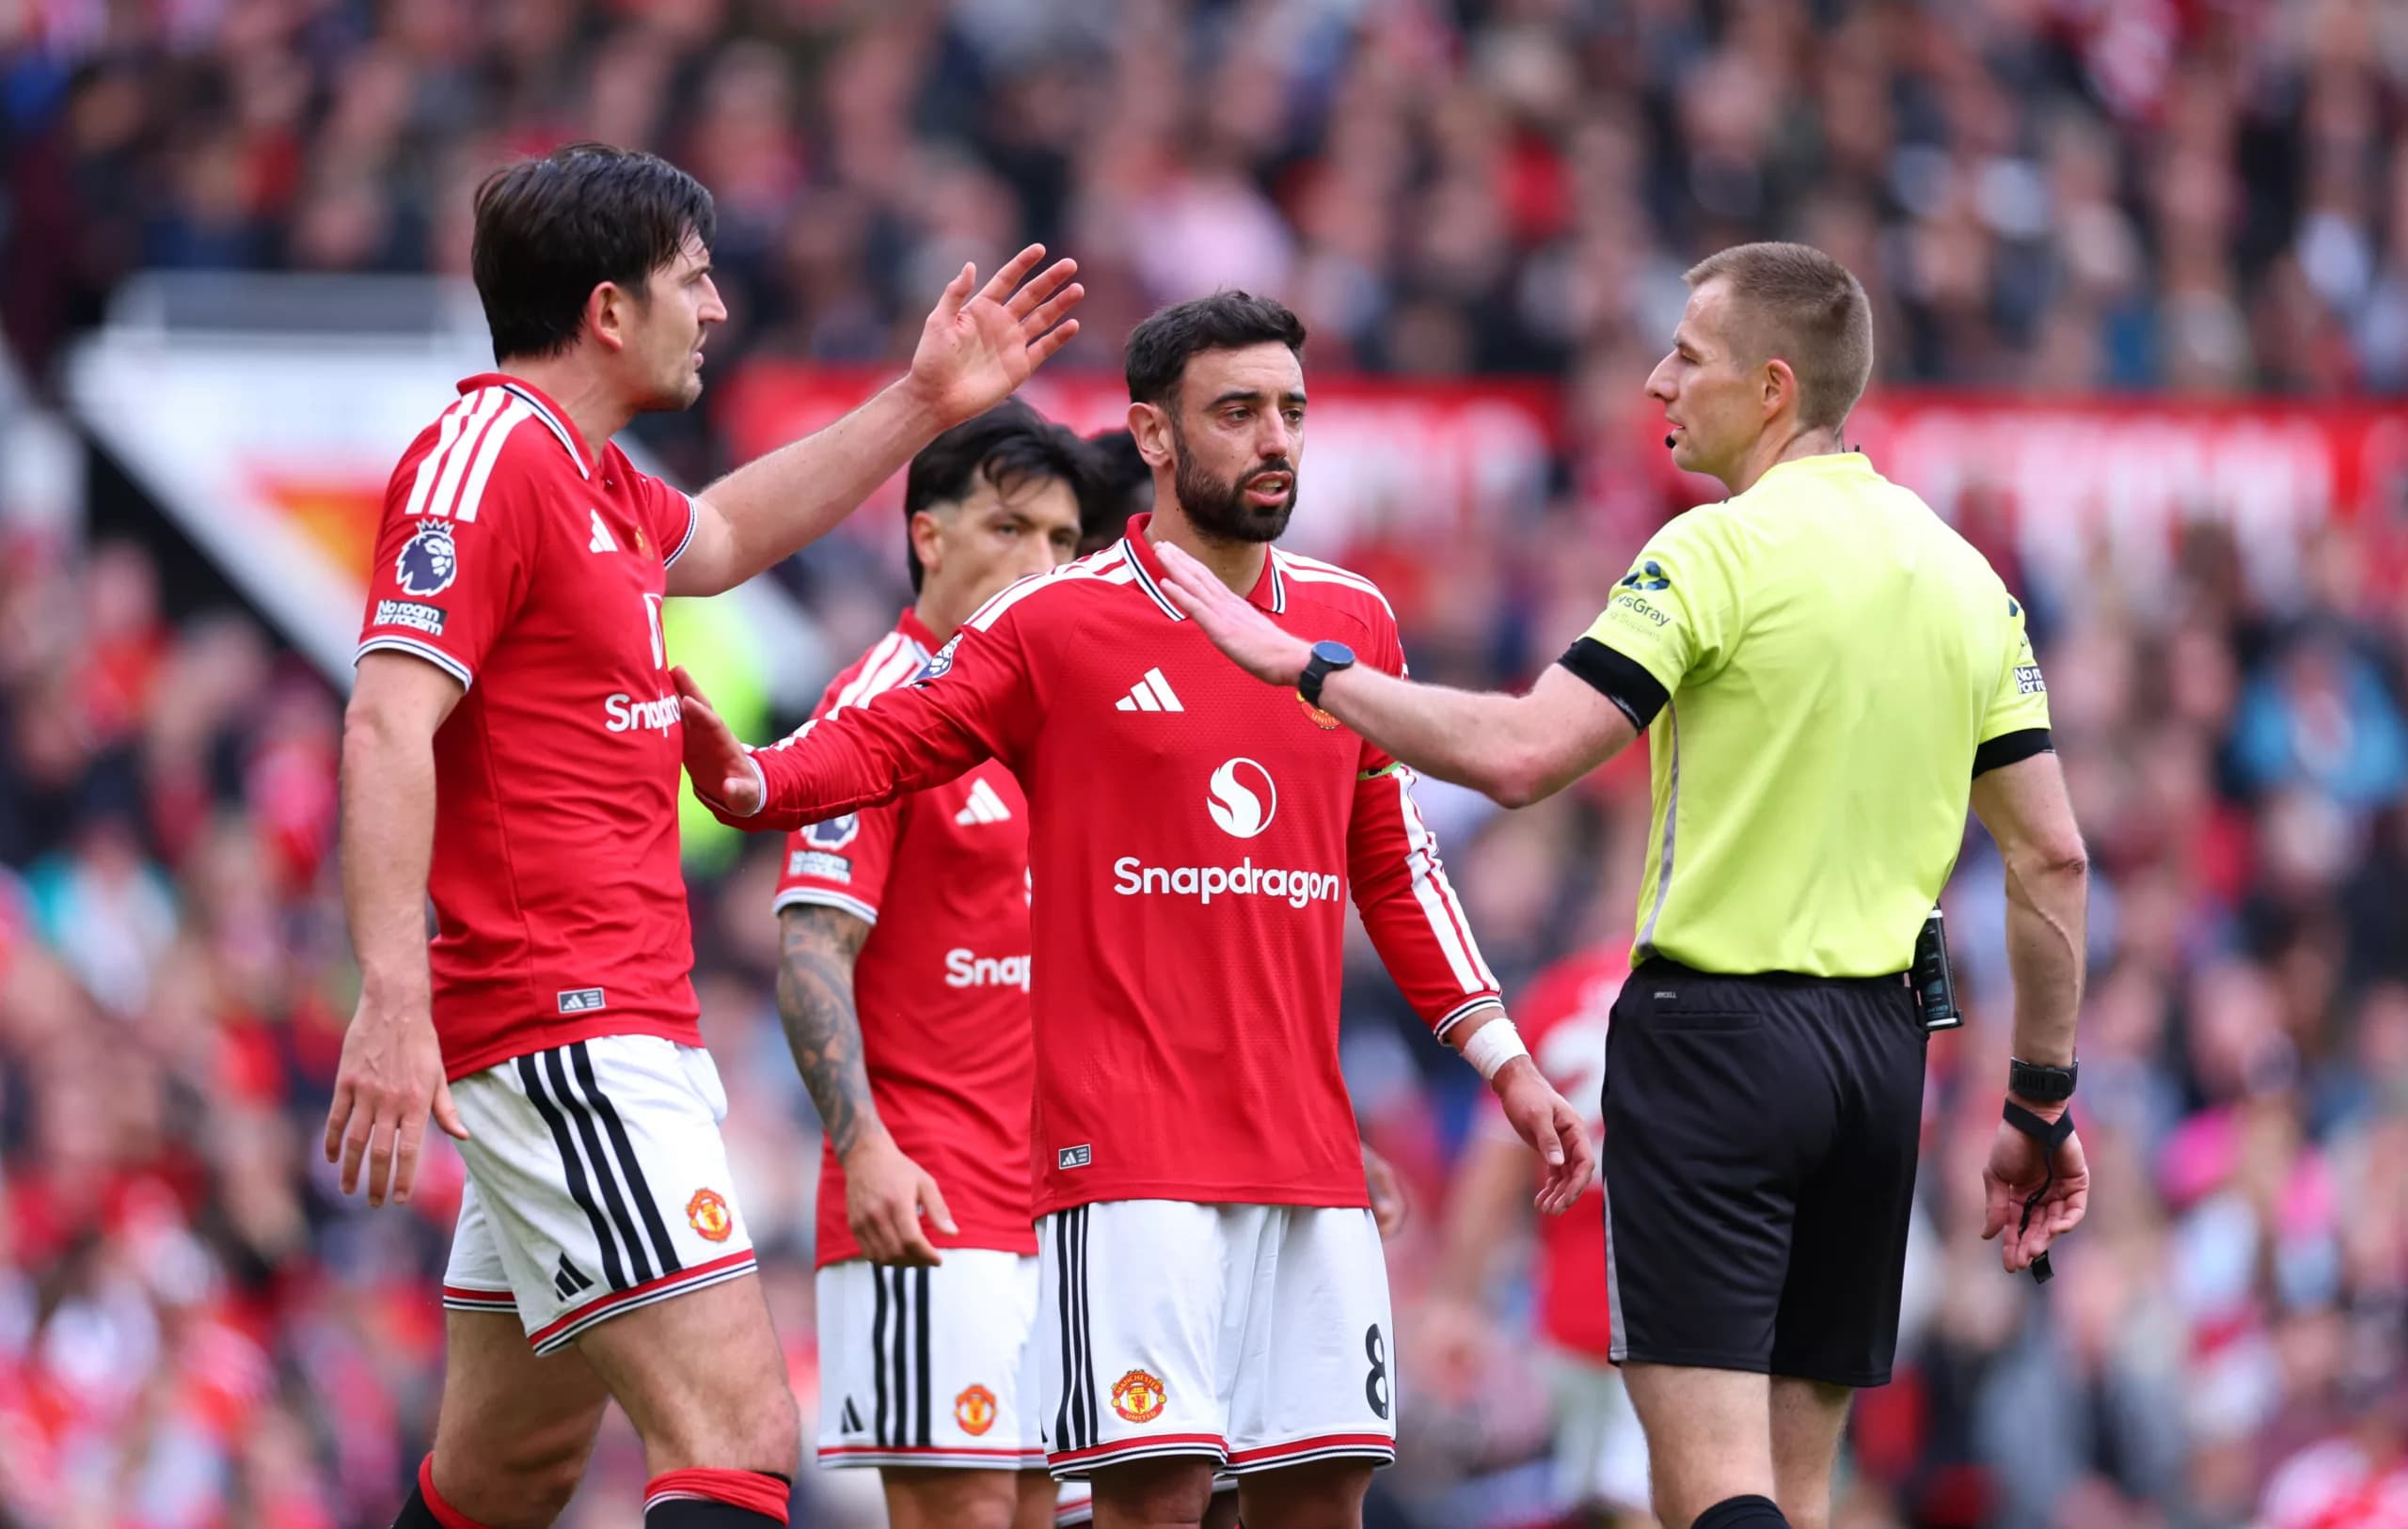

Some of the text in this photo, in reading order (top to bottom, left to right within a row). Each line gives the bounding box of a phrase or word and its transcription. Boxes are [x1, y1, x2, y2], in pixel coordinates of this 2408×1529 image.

[378, 599, 439, 622] No room
[2014, 667, 2033, 682] No
[2017, 680, 2035, 694] for
[1114, 857, 1339, 908] Snapdragon
[1365, 1323, 1388, 1420] 8
